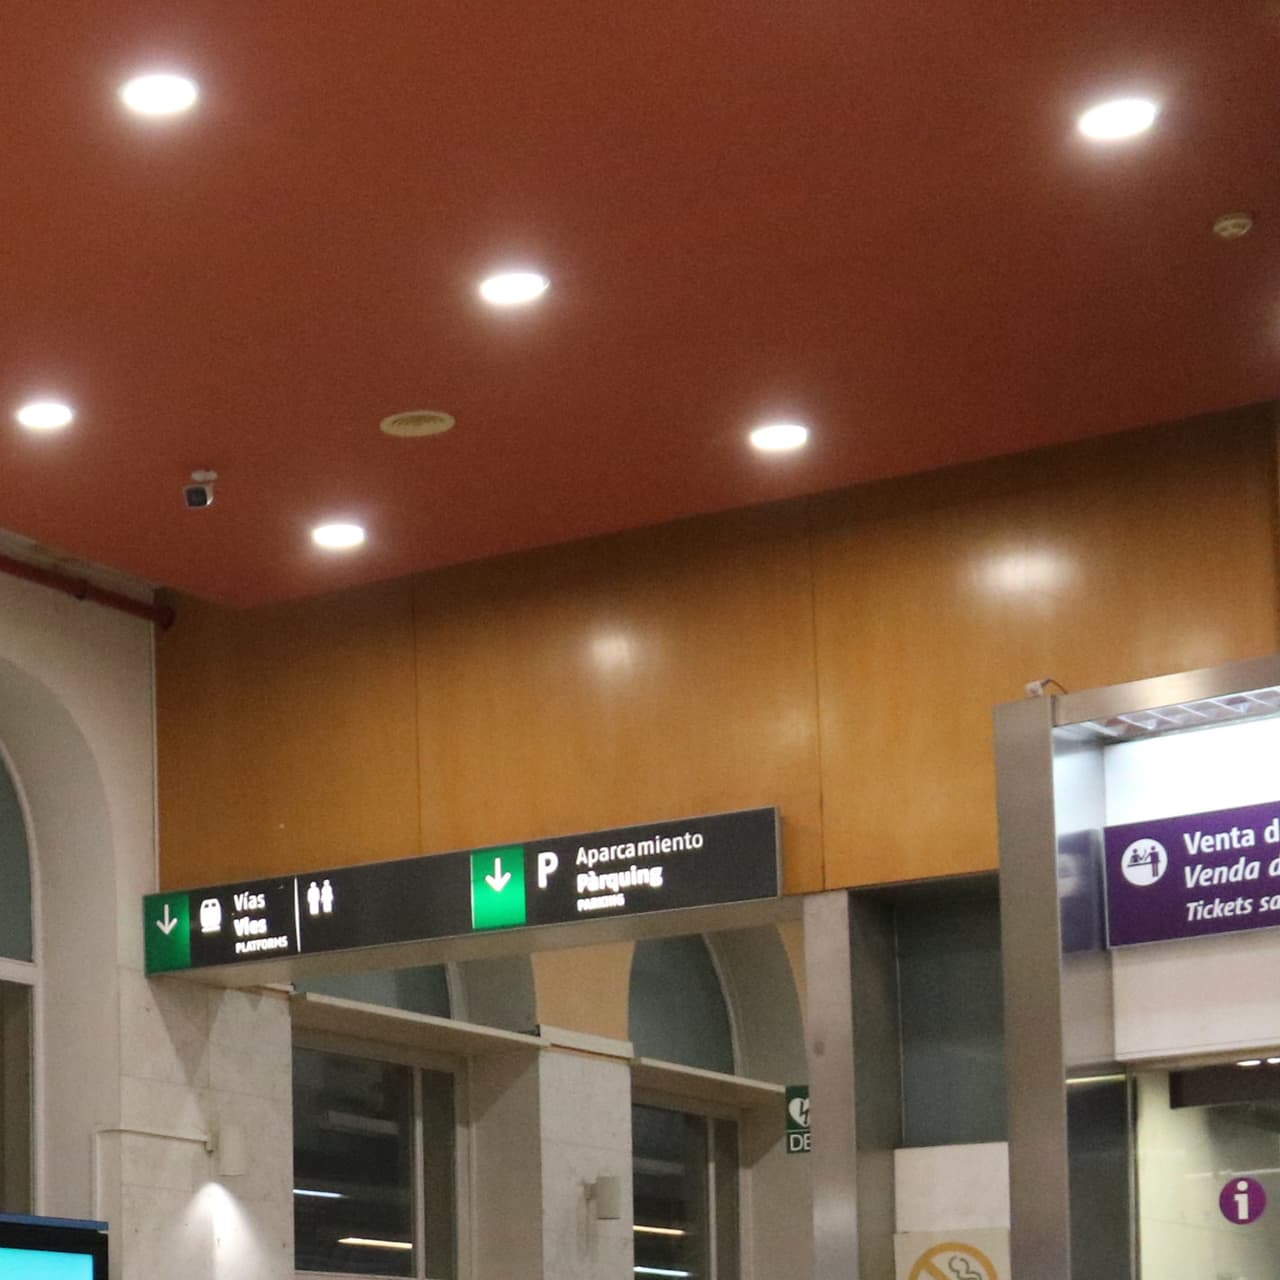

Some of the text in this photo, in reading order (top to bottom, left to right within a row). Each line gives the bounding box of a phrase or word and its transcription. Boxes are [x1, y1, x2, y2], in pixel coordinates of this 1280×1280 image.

[1183, 818, 1280, 855] Venta d
[537, 832, 704, 889] P Aparcamiento
[1184, 856, 1261, 889] Venda
[576, 865, 664, 894] Pàrquing
[233, 891, 266, 912] Vías
[1186, 896, 1254, 921] Tickets
[235, 935, 289, 954] PLATFORMS
[789, 1133, 811, 1151] DE
